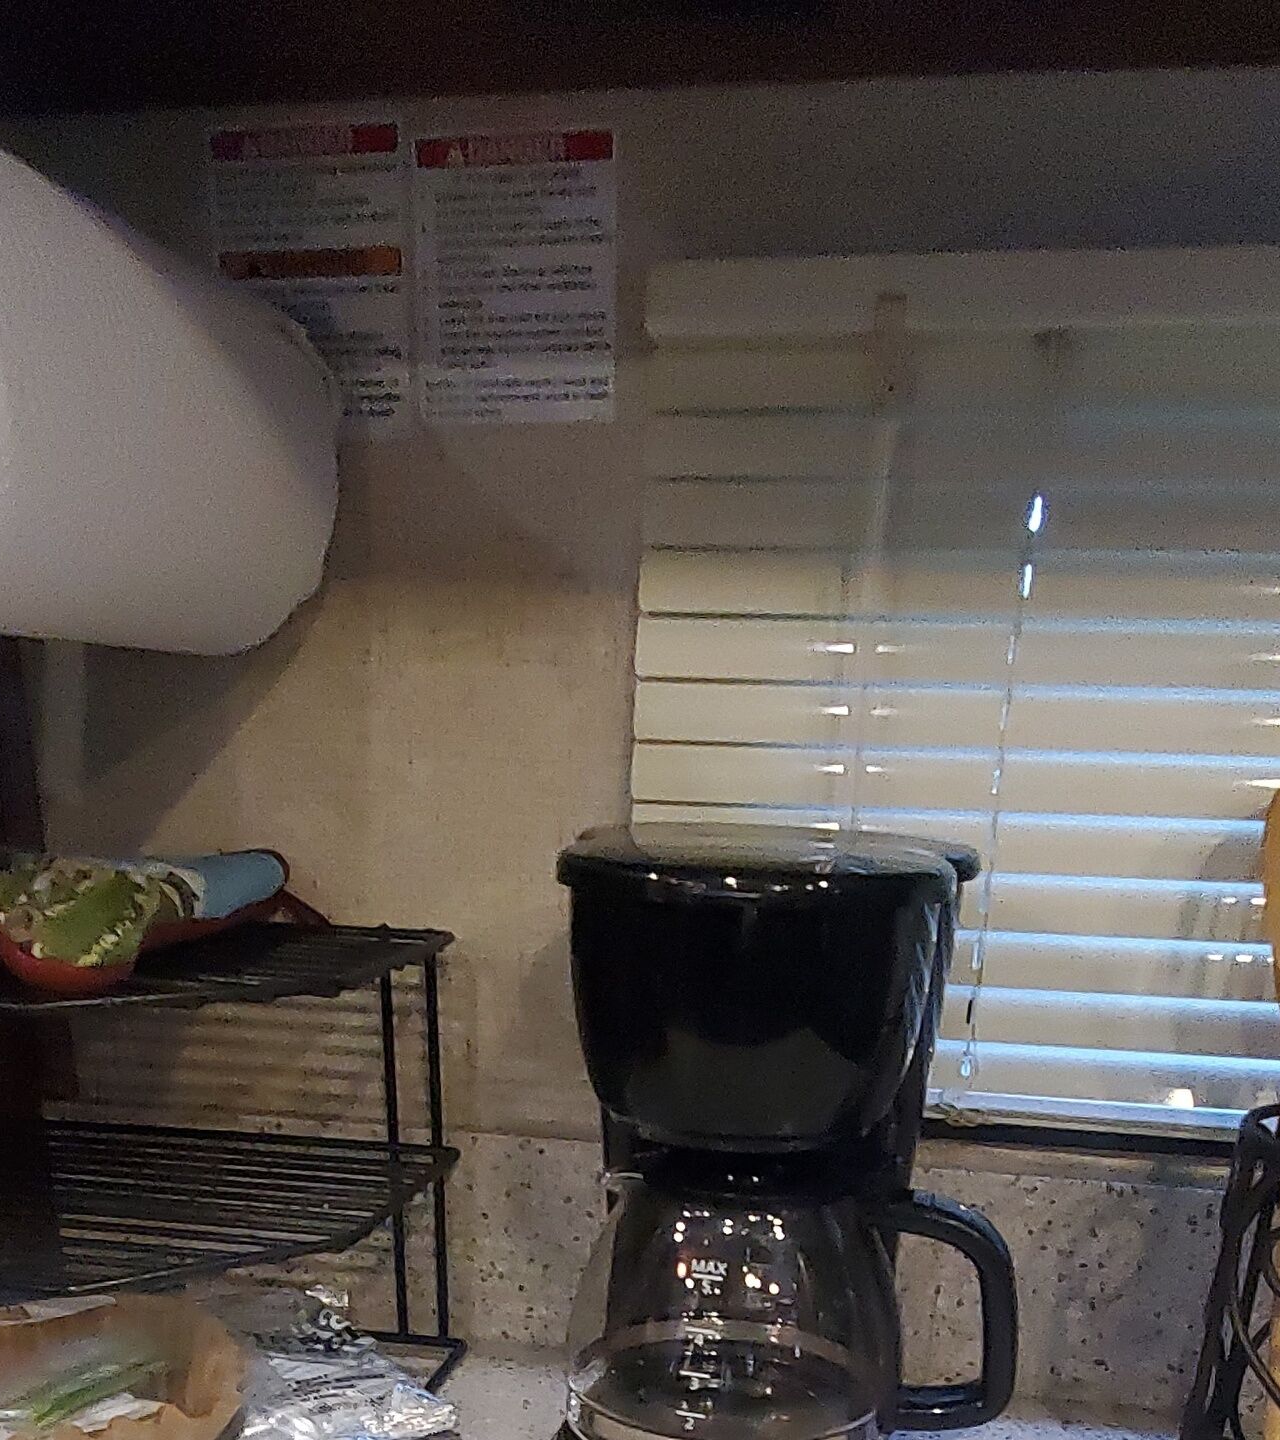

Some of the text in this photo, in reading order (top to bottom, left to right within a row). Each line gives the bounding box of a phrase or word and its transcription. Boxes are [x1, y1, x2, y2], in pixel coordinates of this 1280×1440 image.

[691, 1258, 728, 1277] MAX
[690, 1377, 699, 1391] 3
[684, 1416, 694, 1431] 2
